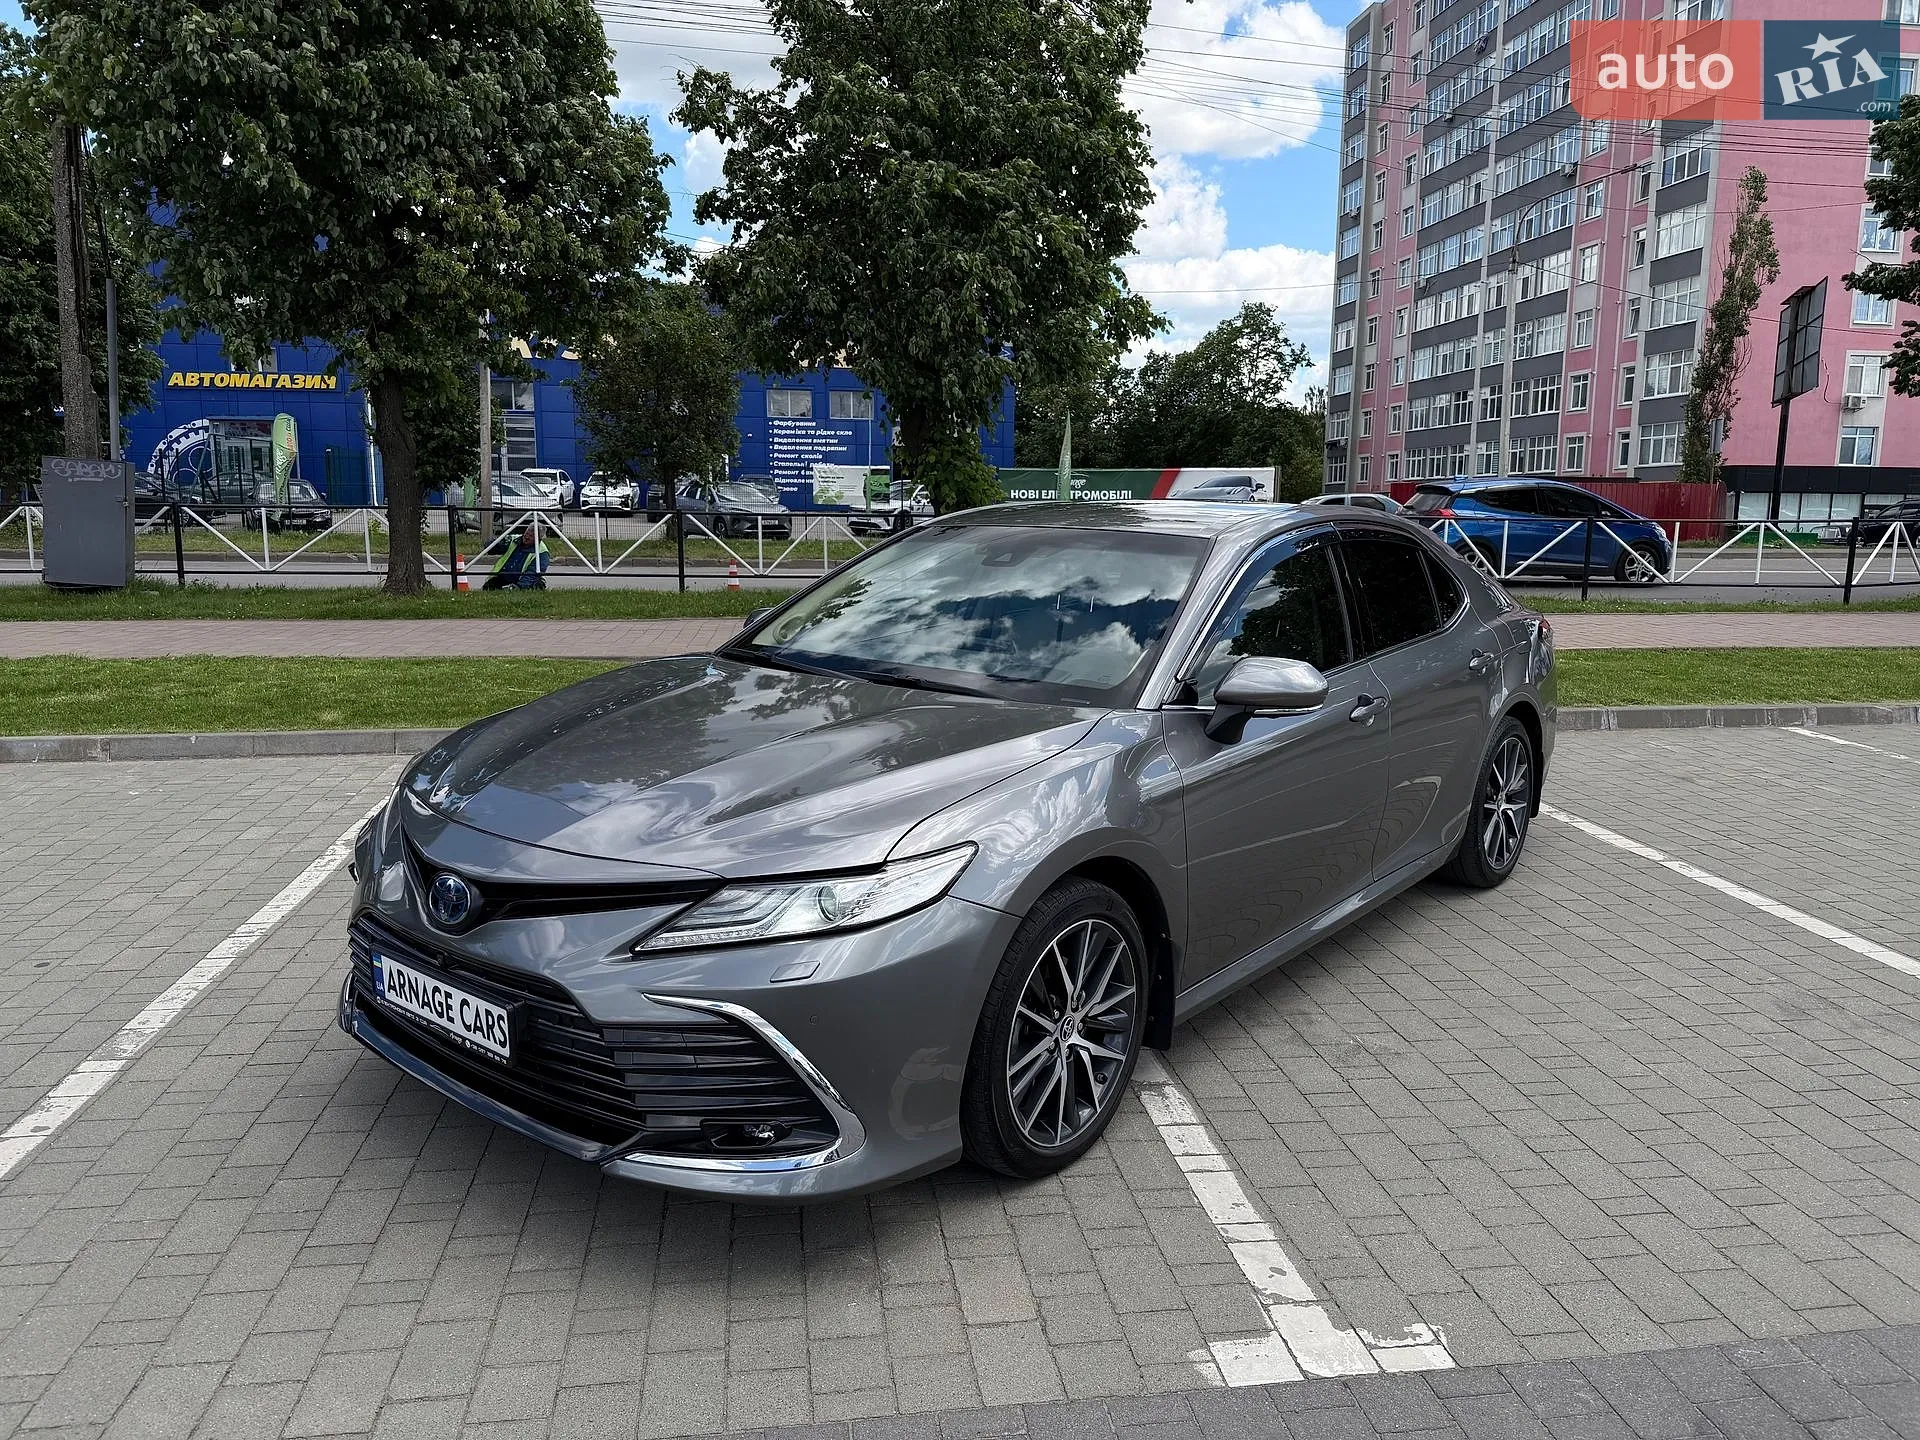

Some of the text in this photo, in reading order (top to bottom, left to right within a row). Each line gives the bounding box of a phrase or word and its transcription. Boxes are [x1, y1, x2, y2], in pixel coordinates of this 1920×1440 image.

[168, 372, 337, 389] АВТОМАГАЗИН
[773, 428, 806, 436] Кераміка
[773, 437, 812, 445] Видалення
[1010, 489, 1132, 501] НОВІ ЕЛТРОМОБІЛІ
[376, 980, 384, 991] UA
[387, 965, 455, 1025] ARNAGE
[459, 998, 508, 1049] CARS
